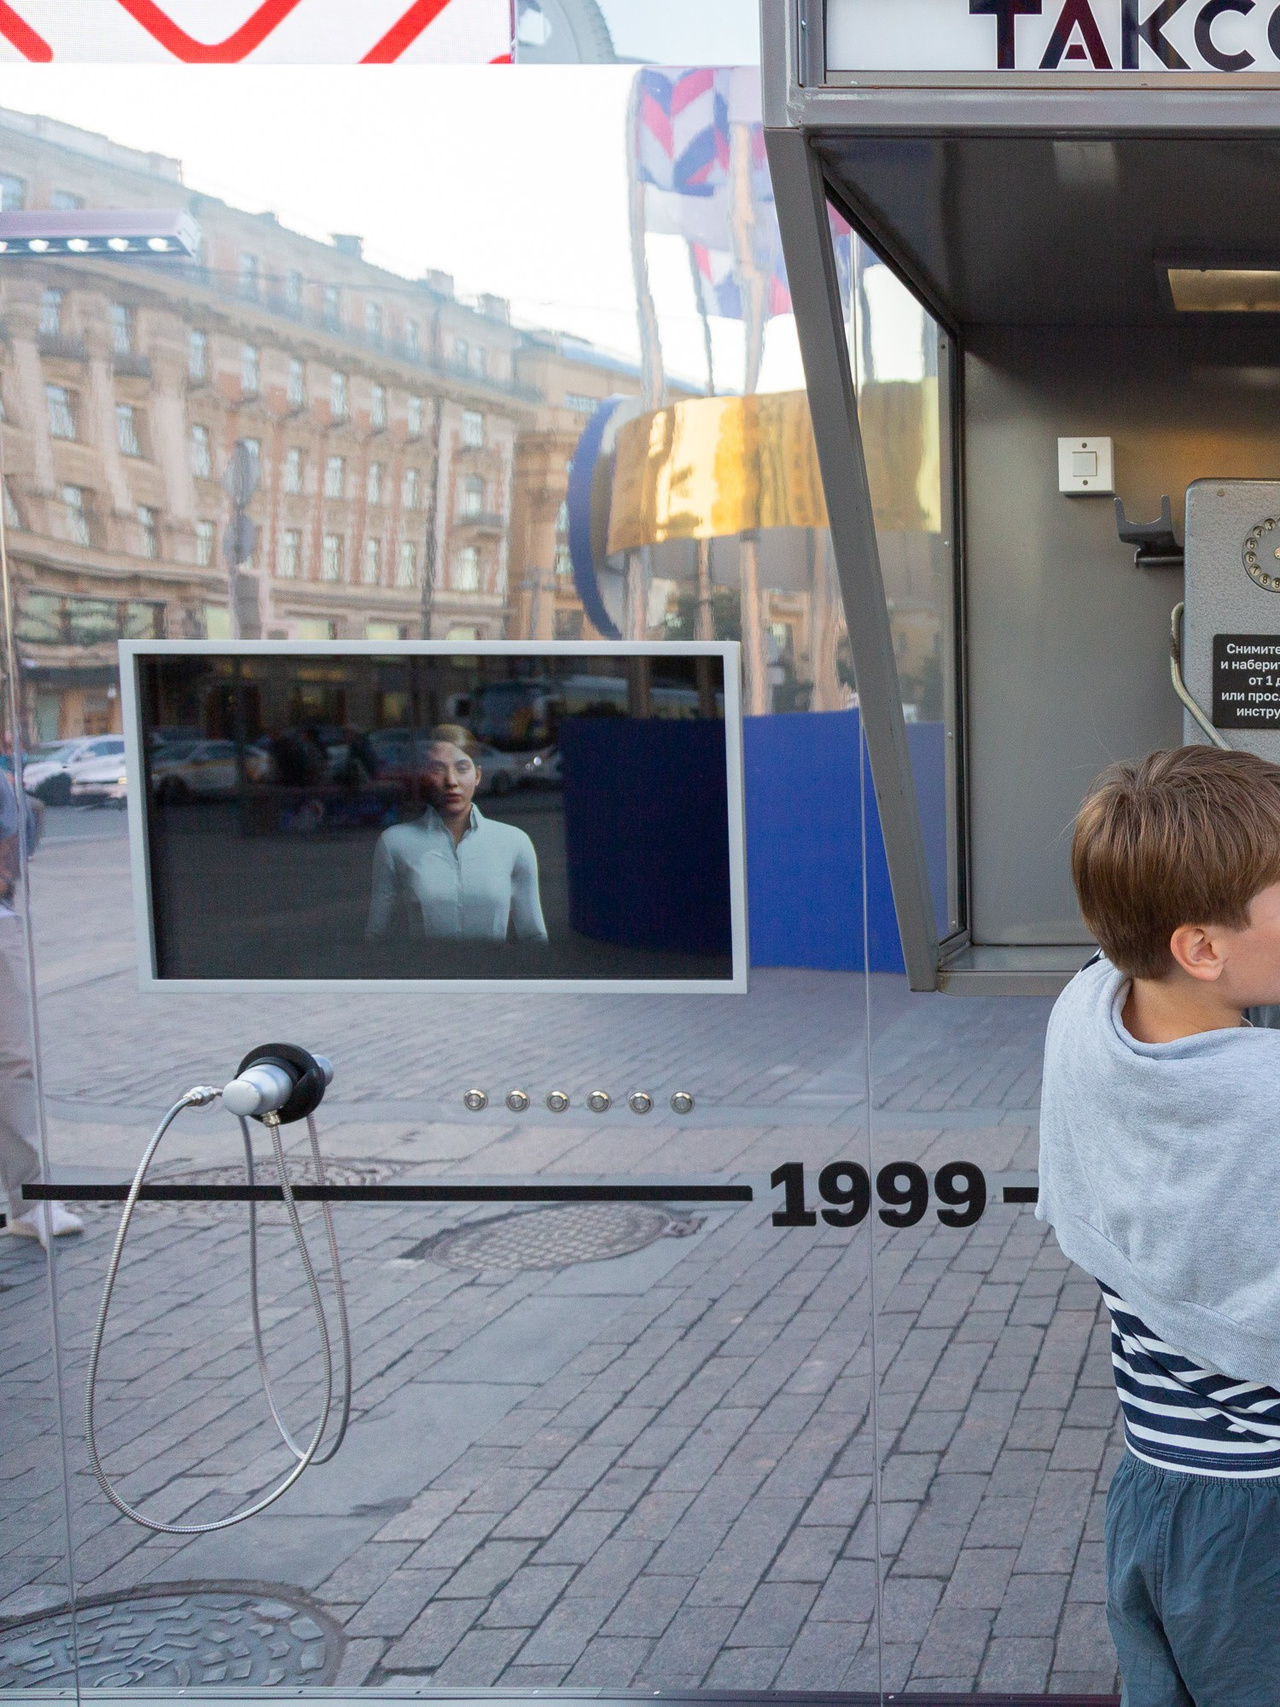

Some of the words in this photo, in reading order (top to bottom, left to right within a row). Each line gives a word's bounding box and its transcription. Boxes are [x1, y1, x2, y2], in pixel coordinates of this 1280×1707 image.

[1267, 521, 1273, 531] 3
[1256, 529, 1262, 538] 4
[1249, 540, 1256, 550] 5
[1248, 553, 1254, 563] 6
[1252, 566, 1259, 575] 7
[1262, 575, 1268, 585] 8
[1274, 580, 1280, 589] 9
[1220, 661, 1229, 670] и
[1248, 676, 1263, 686] от
[1265, 675, 1273, 686] 1
[1221, 692, 1245, 701] или
[770, 1160, 987, 1228] 1999
